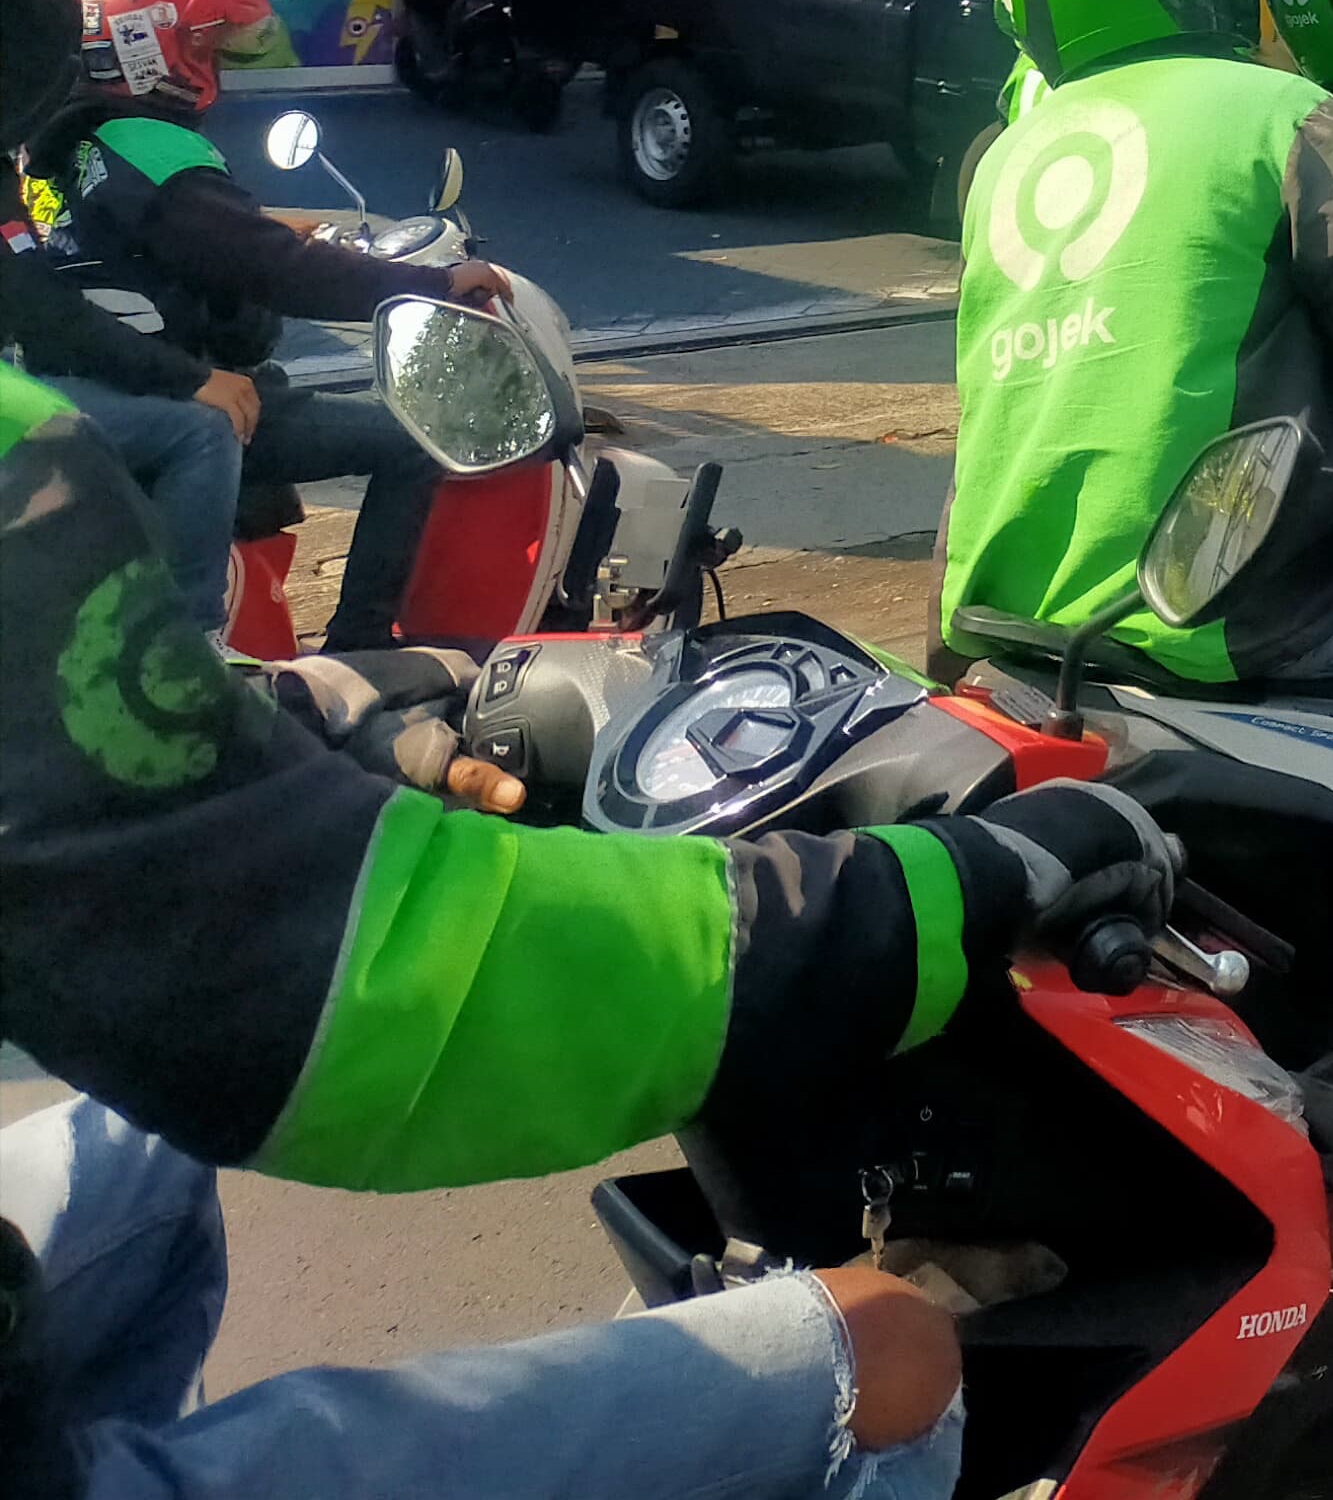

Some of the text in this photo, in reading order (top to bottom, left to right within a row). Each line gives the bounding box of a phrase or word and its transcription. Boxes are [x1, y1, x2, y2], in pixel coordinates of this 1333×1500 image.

[1284, 8, 1320, 30] gojek
[990, 299, 1117, 382] gojek
[1236, 1302, 1308, 1341] HONDA
